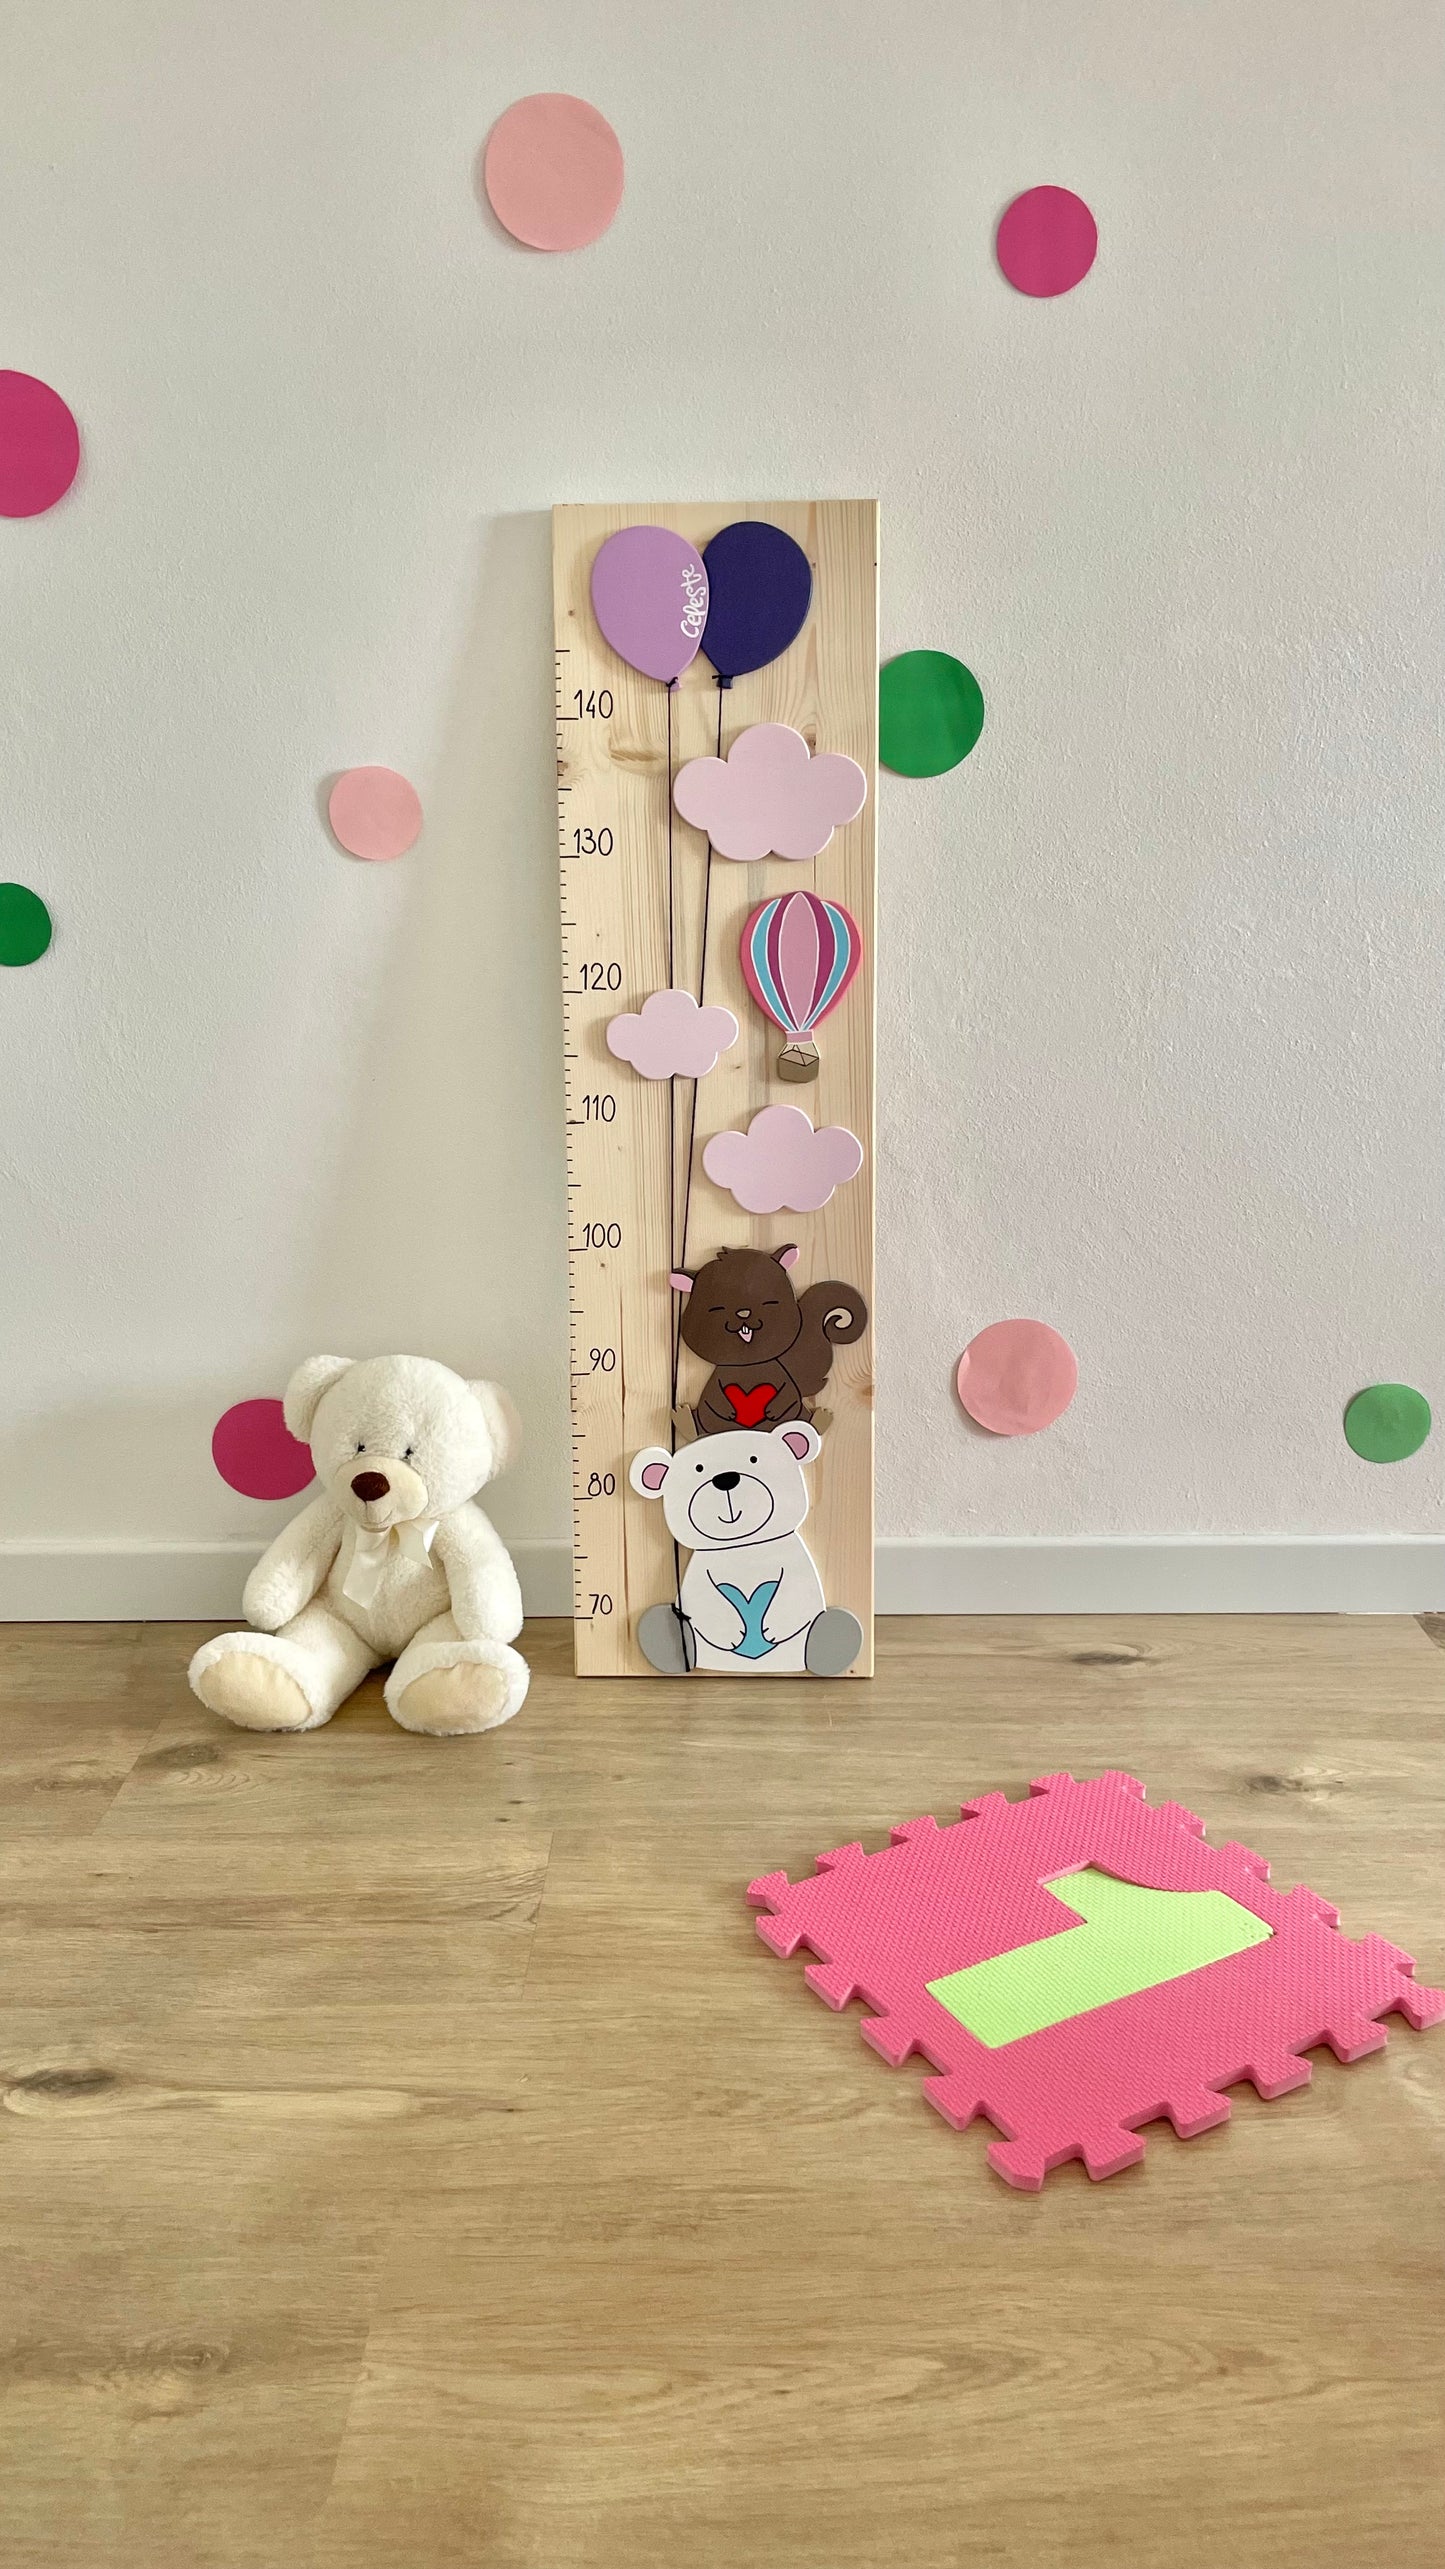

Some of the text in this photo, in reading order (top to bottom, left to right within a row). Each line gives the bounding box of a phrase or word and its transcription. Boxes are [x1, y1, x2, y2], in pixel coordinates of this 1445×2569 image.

[680, 563, 706, 638] Celeste
[573, 689, 614, 719] 140
[573, 828, 614, 856] 130
[579, 962, 622, 991] 120
[581, 1095, 617, 1123] 110
[582, 1223, 622, 1249] 100
[589, 1348, 616, 1373] 90
[587, 1472, 616, 1497] 80
[589, 1594, 614, 1616] 70
